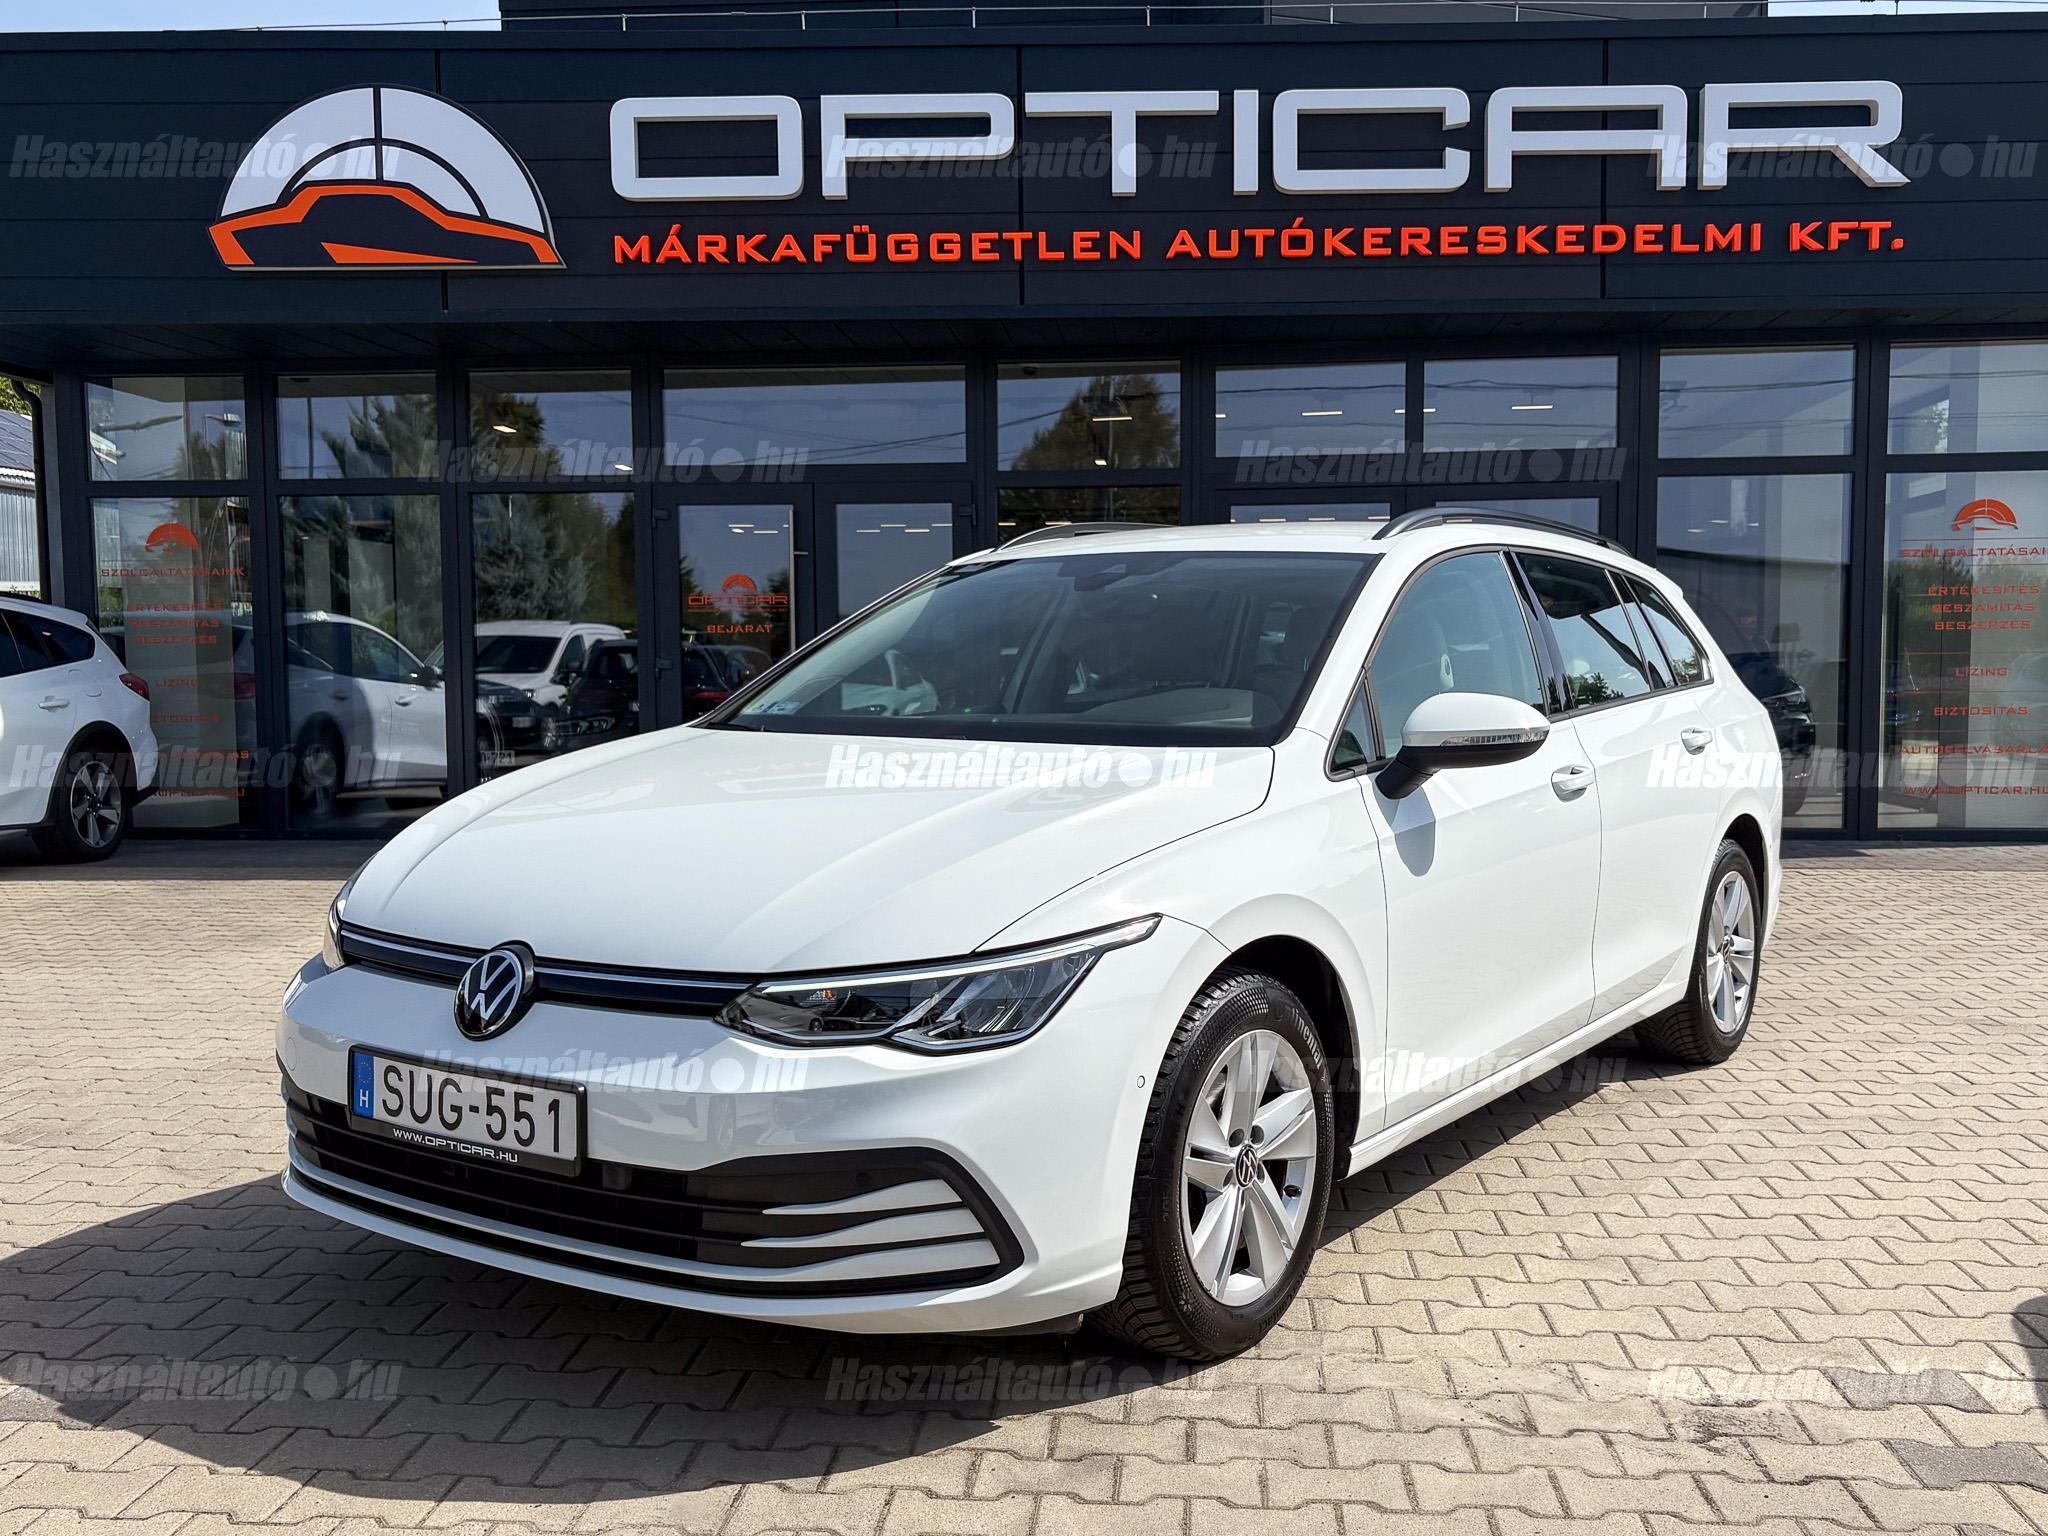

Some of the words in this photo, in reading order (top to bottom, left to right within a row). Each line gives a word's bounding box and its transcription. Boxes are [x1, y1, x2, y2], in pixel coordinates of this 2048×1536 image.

[610, 80, 1911, 202] OPTICAR
[613, 223, 1141, 265] MÁRKAFÜGGETLEN
[1166, 217, 1762, 261] AUTÓKERESKEDELMI
[1789, 220, 1905, 253] KFT.
[381, 1064, 561, 1153] SUG-551
[393, 1127, 518, 1163] WWW.OPTICAR.HU
